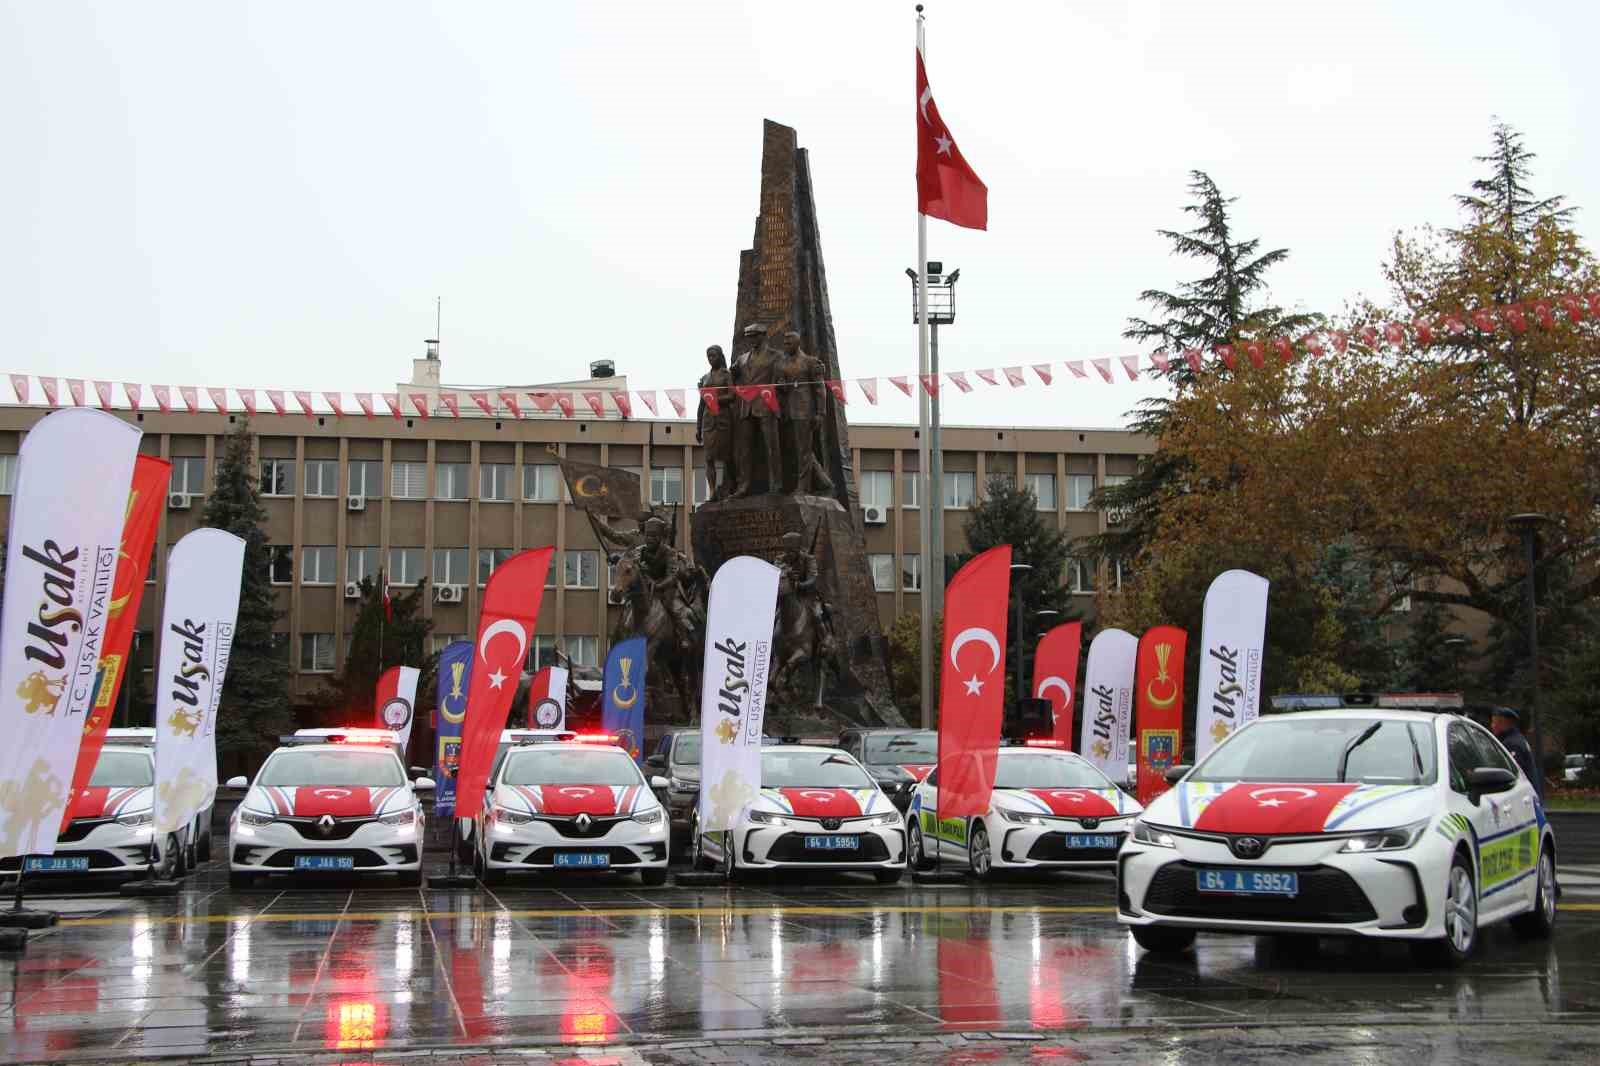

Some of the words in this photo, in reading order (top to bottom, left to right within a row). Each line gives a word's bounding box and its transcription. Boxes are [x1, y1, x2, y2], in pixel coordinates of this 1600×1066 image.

[79, 626, 100, 675] UŞAK
[558, 854, 569, 865] 64
[578, 854, 593, 866] JAA
[1206, 871, 1224, 889] 64
[1235, 871, 1245, 890] A
[1252, 872, 1292, 891] 5952
